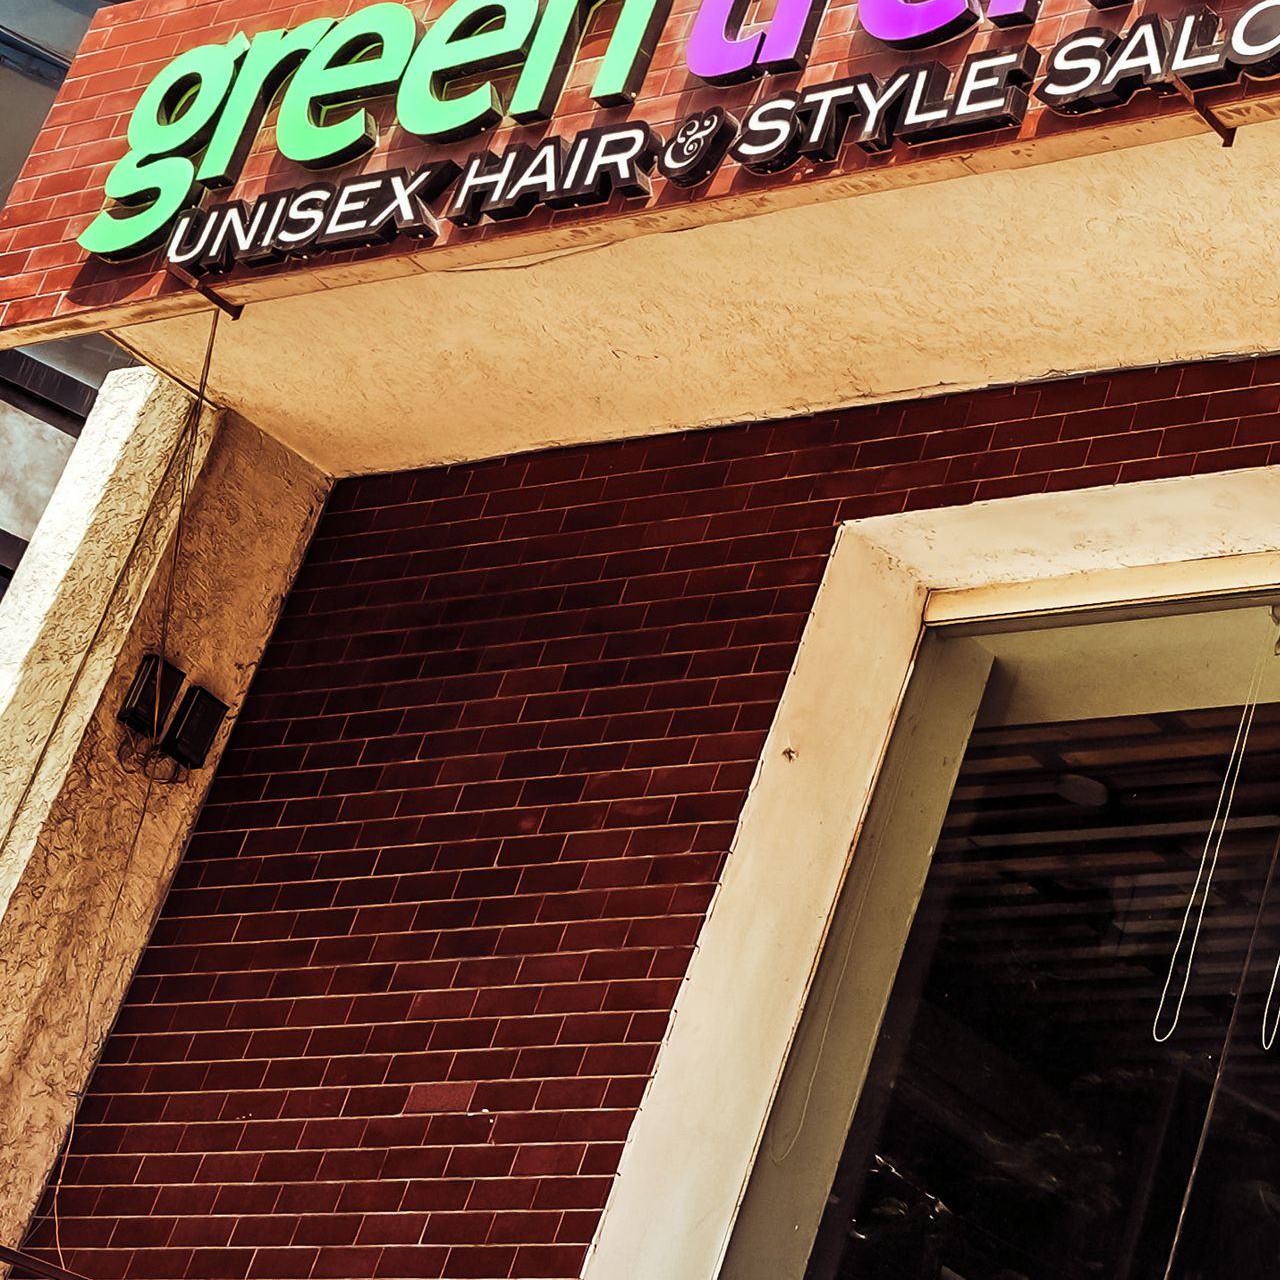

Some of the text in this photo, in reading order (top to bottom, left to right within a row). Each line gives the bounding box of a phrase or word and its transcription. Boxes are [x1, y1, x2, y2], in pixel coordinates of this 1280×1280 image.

[168, 172, 430, 264] UNISEX
[456, 128, 646, 208] HAIR
[664, 114, 718, 170] &
[739, 54, 1018, 156] STYLE
